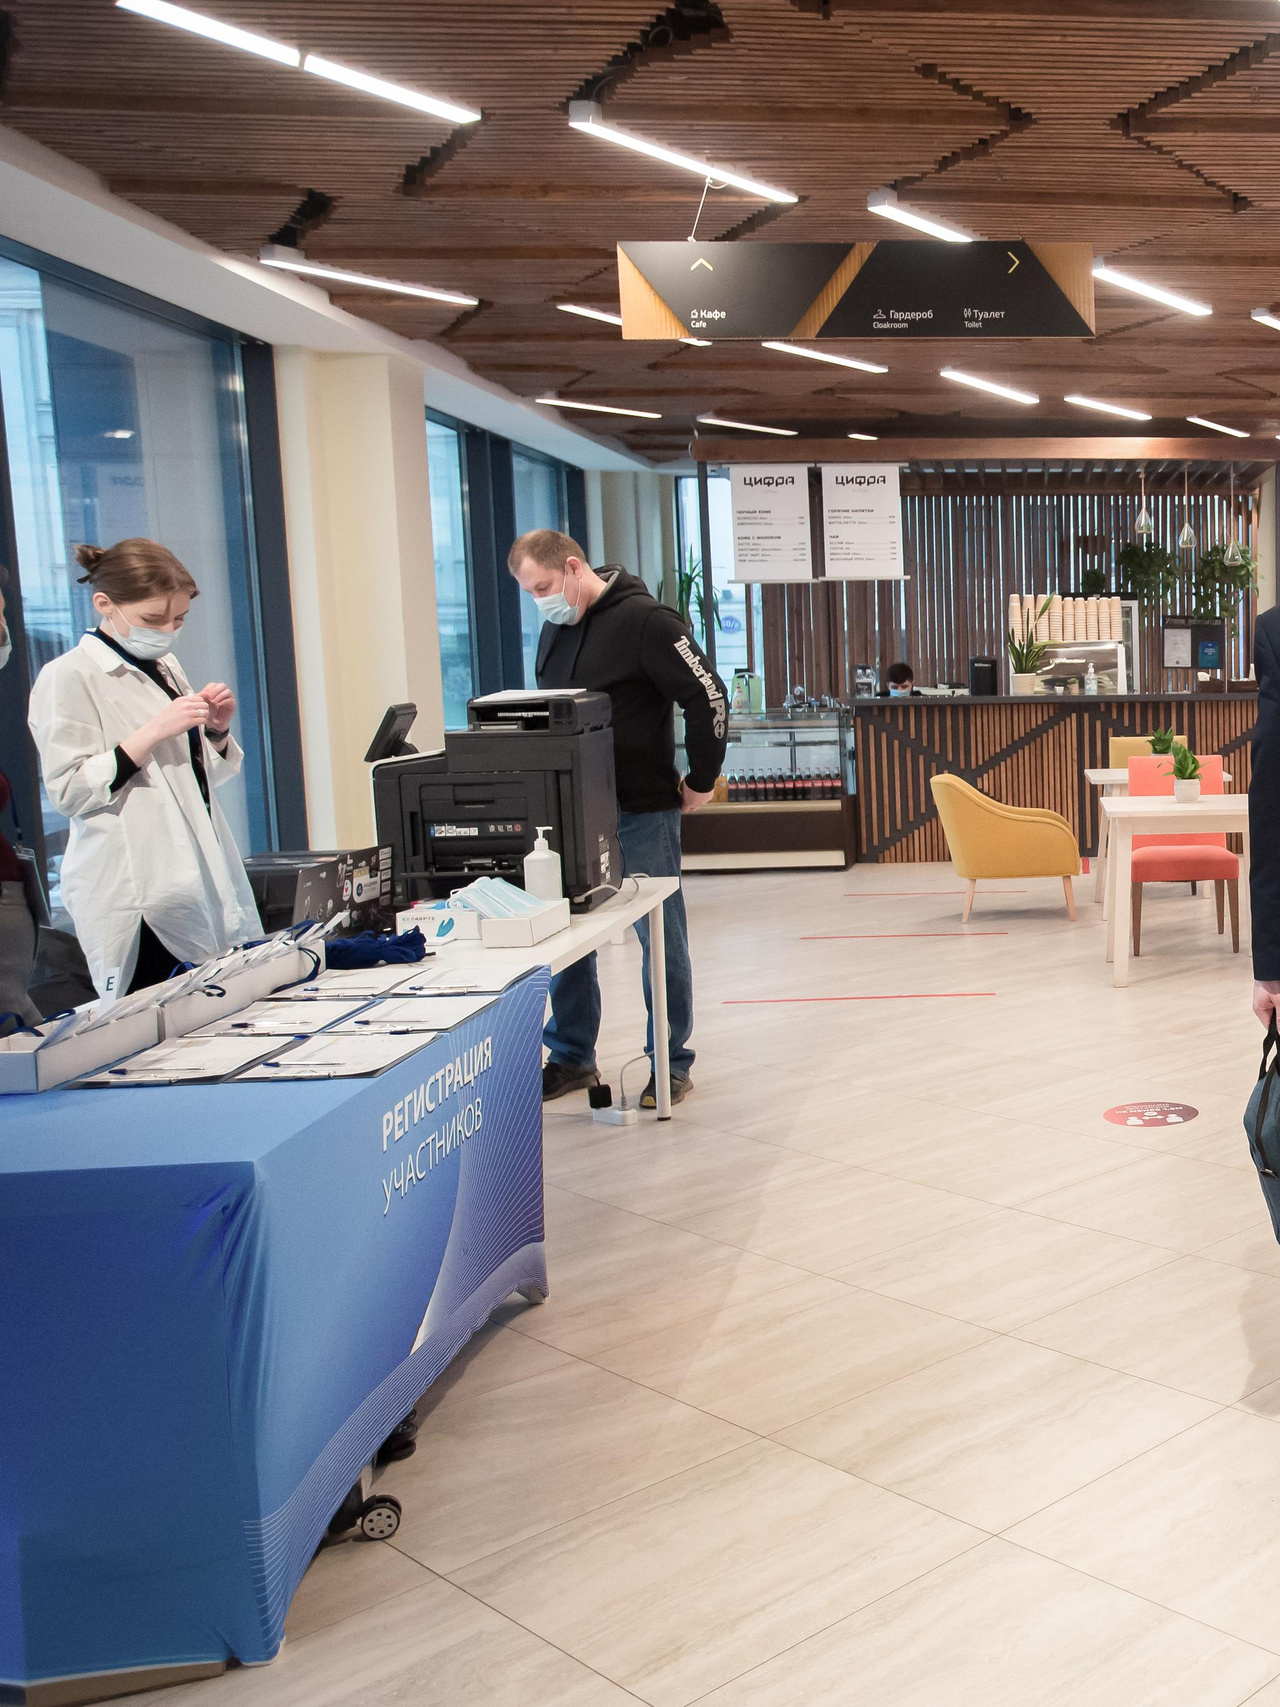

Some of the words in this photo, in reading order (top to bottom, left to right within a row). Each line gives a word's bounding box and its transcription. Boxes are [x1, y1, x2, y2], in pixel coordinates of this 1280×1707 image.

[700, 309, 726, 320] Кафе
[889, 309, 934, 321] Гардероб
[972, 309, 1005, 320] Туалет
[690, 320, 707, 328] Cafe
[872, 321, 909, 329] Cloakroom
[743, 476, 795, 487] ЦИФРА
[835, 475, 886, 487] ЦИФРА
[674, 635, 723, 700] Timberland
[382, 1036, 492, 1152] РЕГИСТРАЦИЯ
[382, 1097, 483, 1215] УЧАСТНИКОВ
